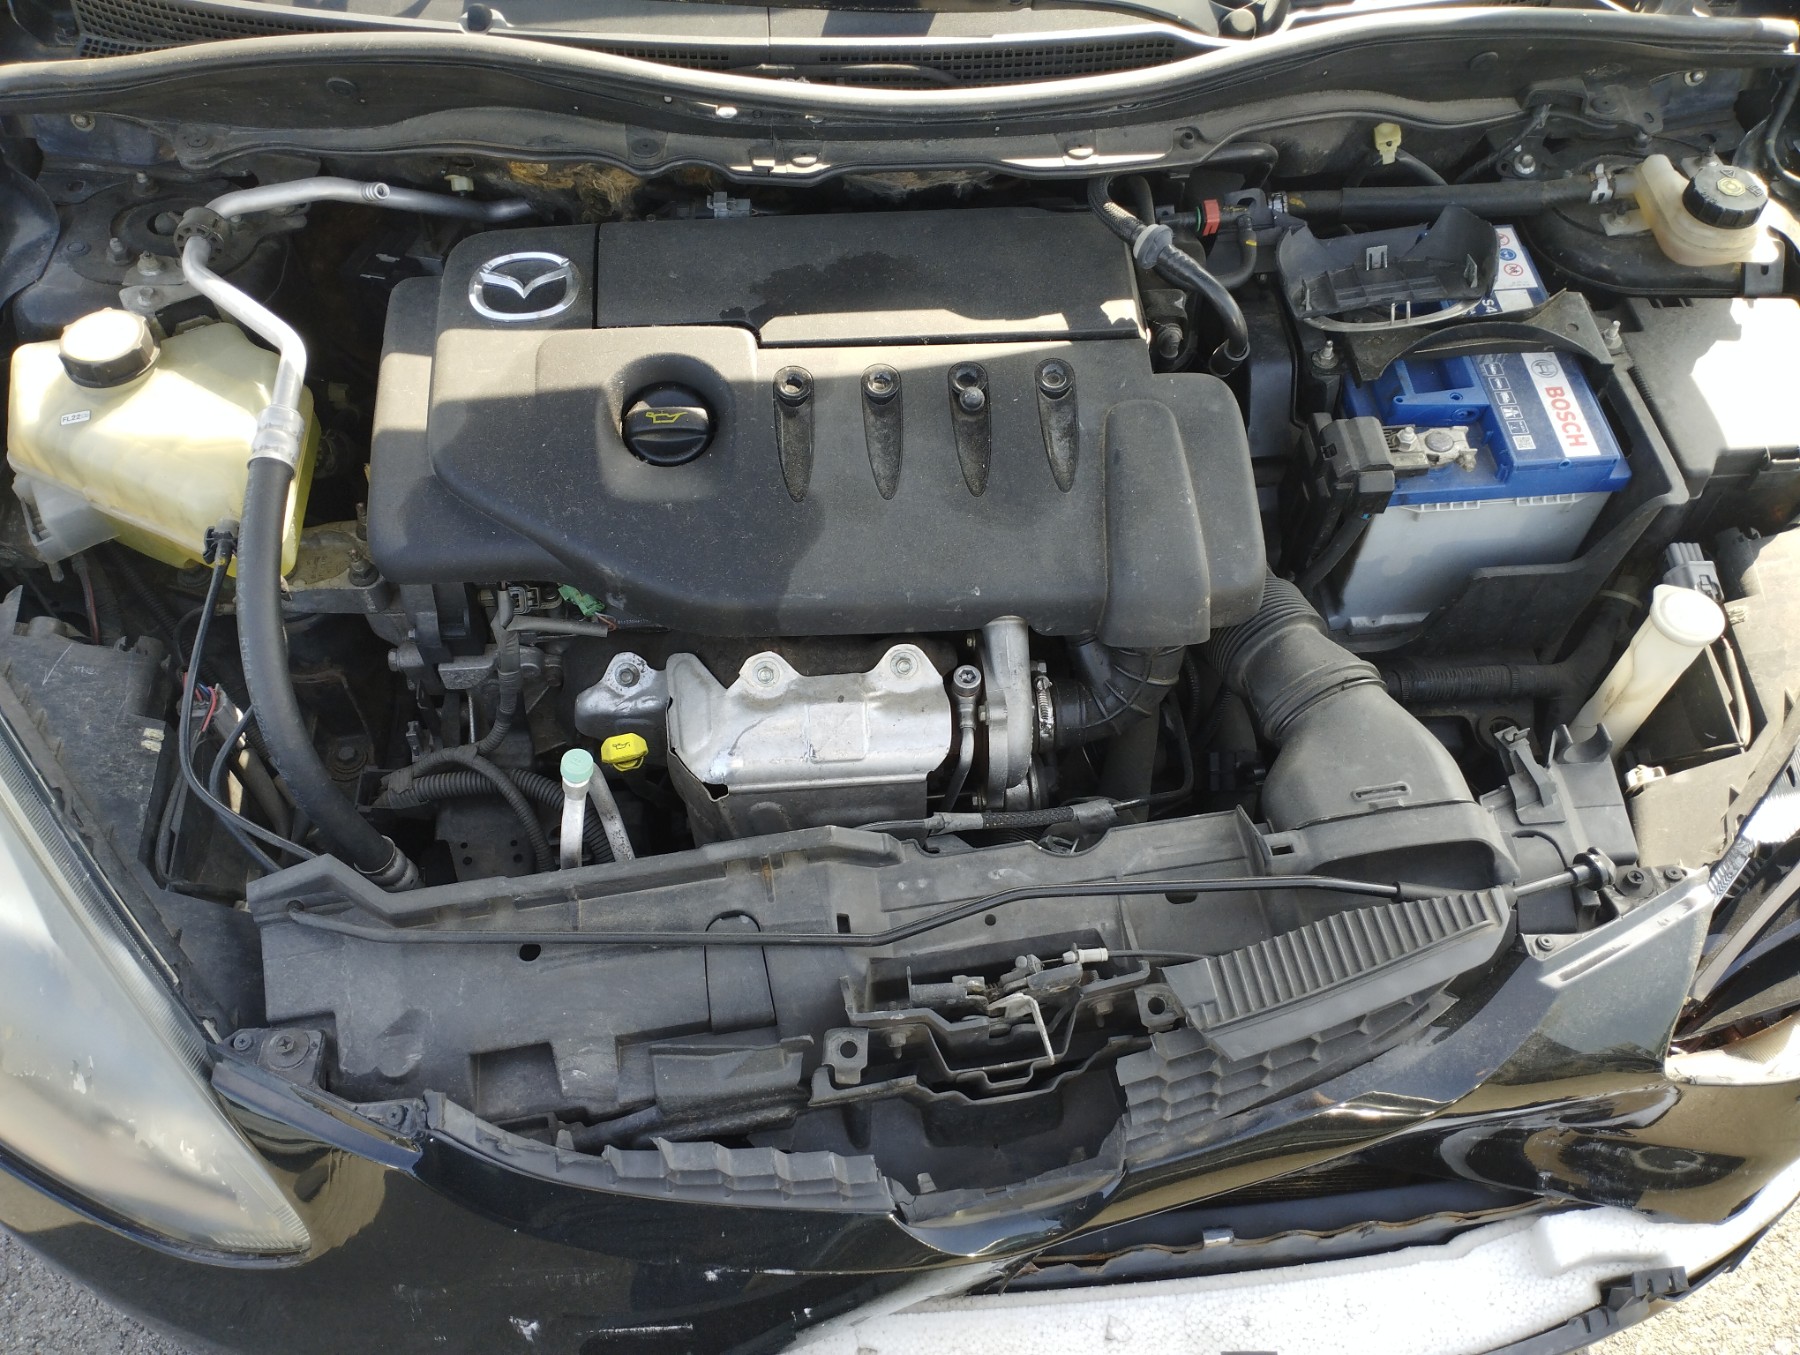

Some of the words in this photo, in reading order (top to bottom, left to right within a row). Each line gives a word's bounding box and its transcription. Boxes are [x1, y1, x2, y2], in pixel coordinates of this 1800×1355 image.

[1482, 299, 1498, 314] S4
[62, 414, 80, 422] FL22
[1544, 386, 1588, 448] BOSCH
